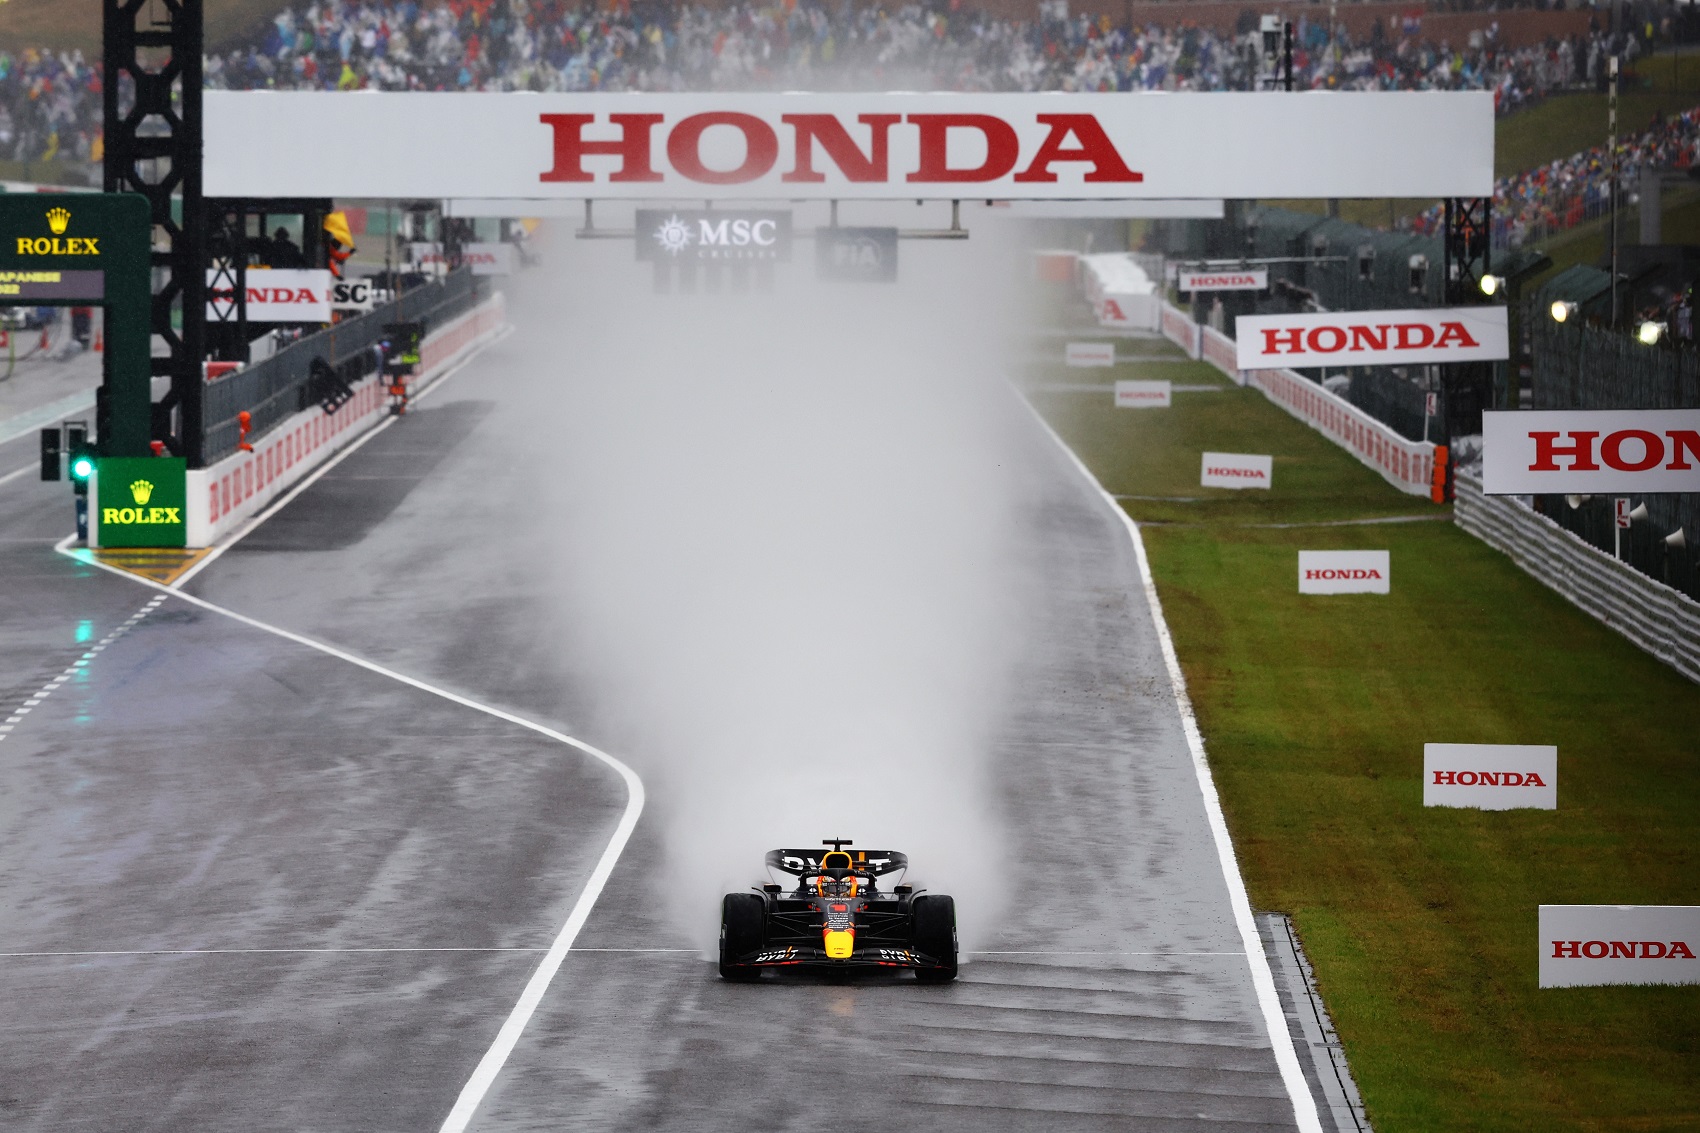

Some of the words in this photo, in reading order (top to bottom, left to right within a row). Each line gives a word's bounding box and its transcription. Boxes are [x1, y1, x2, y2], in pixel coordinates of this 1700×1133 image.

[539, 111, 1144, 184] HONDA
[698, 219, 777, 246] MSC
[16, 237, 100, 256] ROLEX
[1190, 275, 1257, 287] HONDA
[333, 283, 368, 304] SC
[1261, 322, 1479, 355] HONDA
[1207, 467, 1265, 479] HONDA
[103, 508, 181, 524] ROLEX
[1305, 569, 1382, 580] HONDA
[1433, 771, 1546, 787] HONDA
[1551, 940, 1697, 959] HONDA
